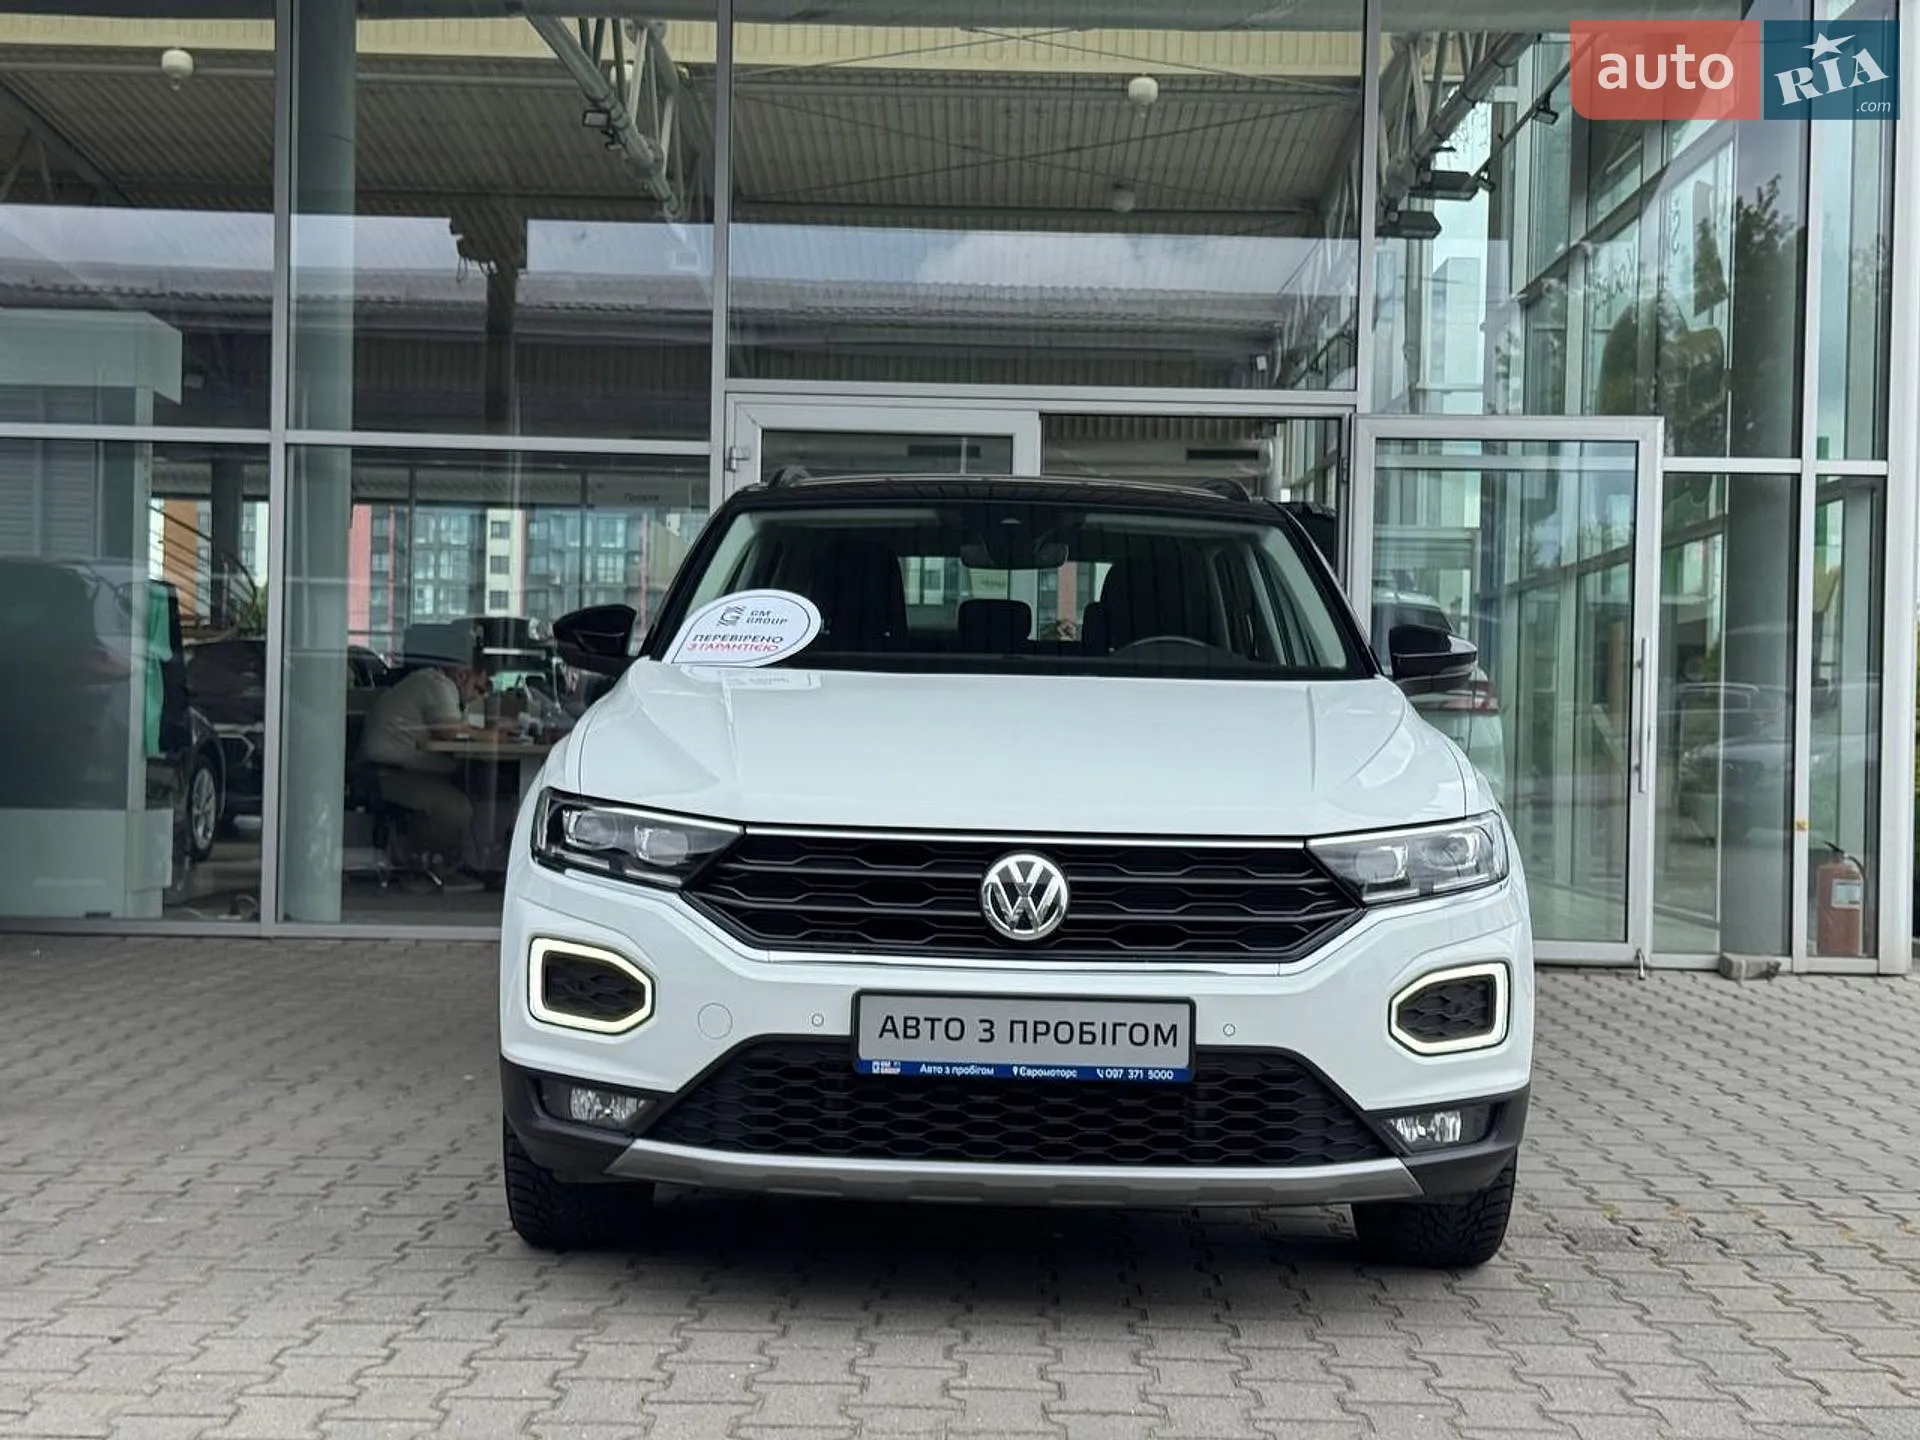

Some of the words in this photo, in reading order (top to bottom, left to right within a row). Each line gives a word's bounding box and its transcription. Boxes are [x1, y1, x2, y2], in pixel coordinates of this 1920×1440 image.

[746, 617, 788, 625] GROUP
[692, 634, 783, 643] ПЕРЕВІРЕНО
[878, 1015, 966, 1042] АВТО
[978, 1019, 996, 1043] З
[1009, 1020, 1178, 1048] ПРОБІГОМ
[919, 1063, 943, 1074] Авто
[951, 1065, 994, 1077] пробігом
[1105, 1068, 1123, 1079] 097
[1128, 1069, 1144, 1080] 371
[1147, 1069, 1174, 1081] 5000
